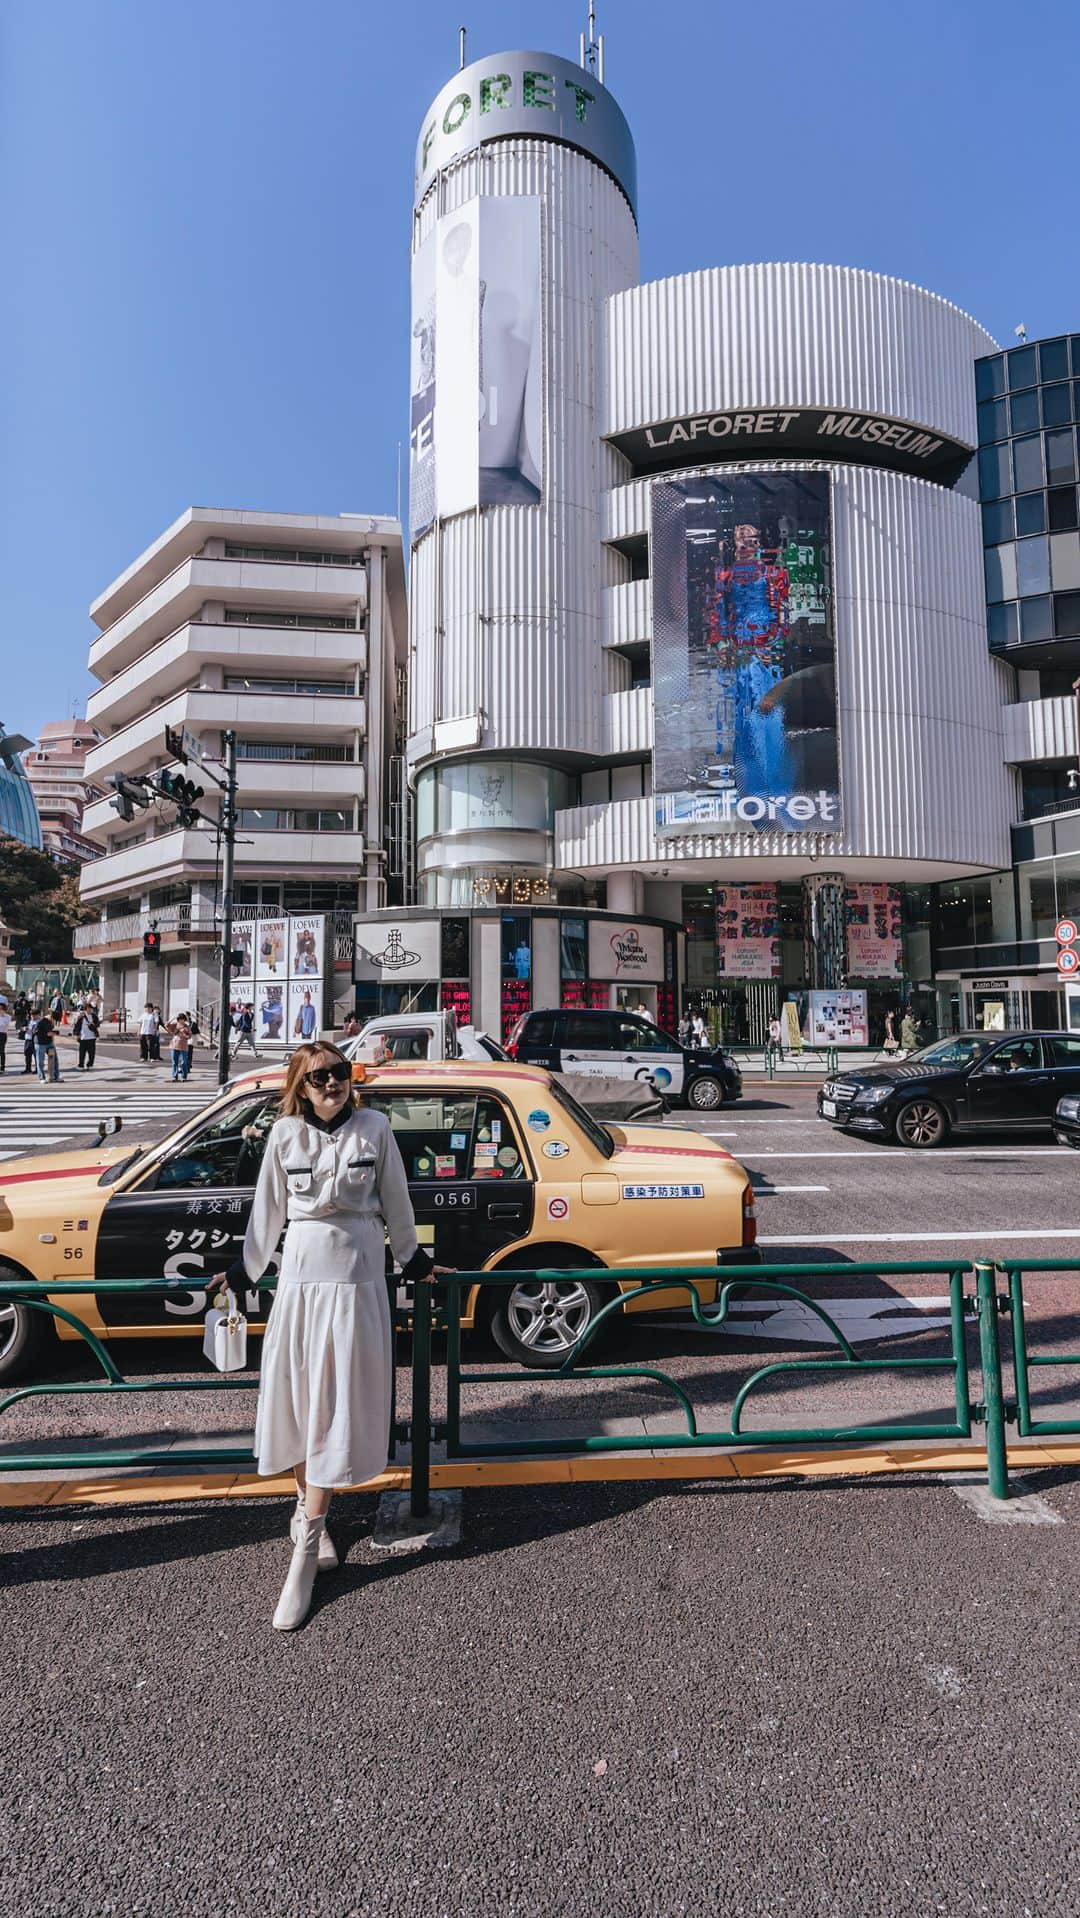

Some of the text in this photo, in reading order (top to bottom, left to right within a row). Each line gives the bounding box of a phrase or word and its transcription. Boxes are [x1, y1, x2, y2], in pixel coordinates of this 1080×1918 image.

[645, 412, 945, 458] LAFORET MUSEUM
[661, 789, 838, 826] Laforet
[473, 877, 550, 902] ovgo
[231, 924, 253, 934] OEWE
[260, 922, 286, 932] LOEWE
[293, 919, 321, 930] LOEWE
[1059, 927, 1072, 939] 50
[230, 985, 252, 995] OEWE
[292, 984, 319, 993] LOEWE
[634, 1067, 673, 1089] GO
[434, 1192, 471, 1206] 056
[186, 1199, 242, 1215] 寿交通
[64, 1247, 83, 1260] 56
